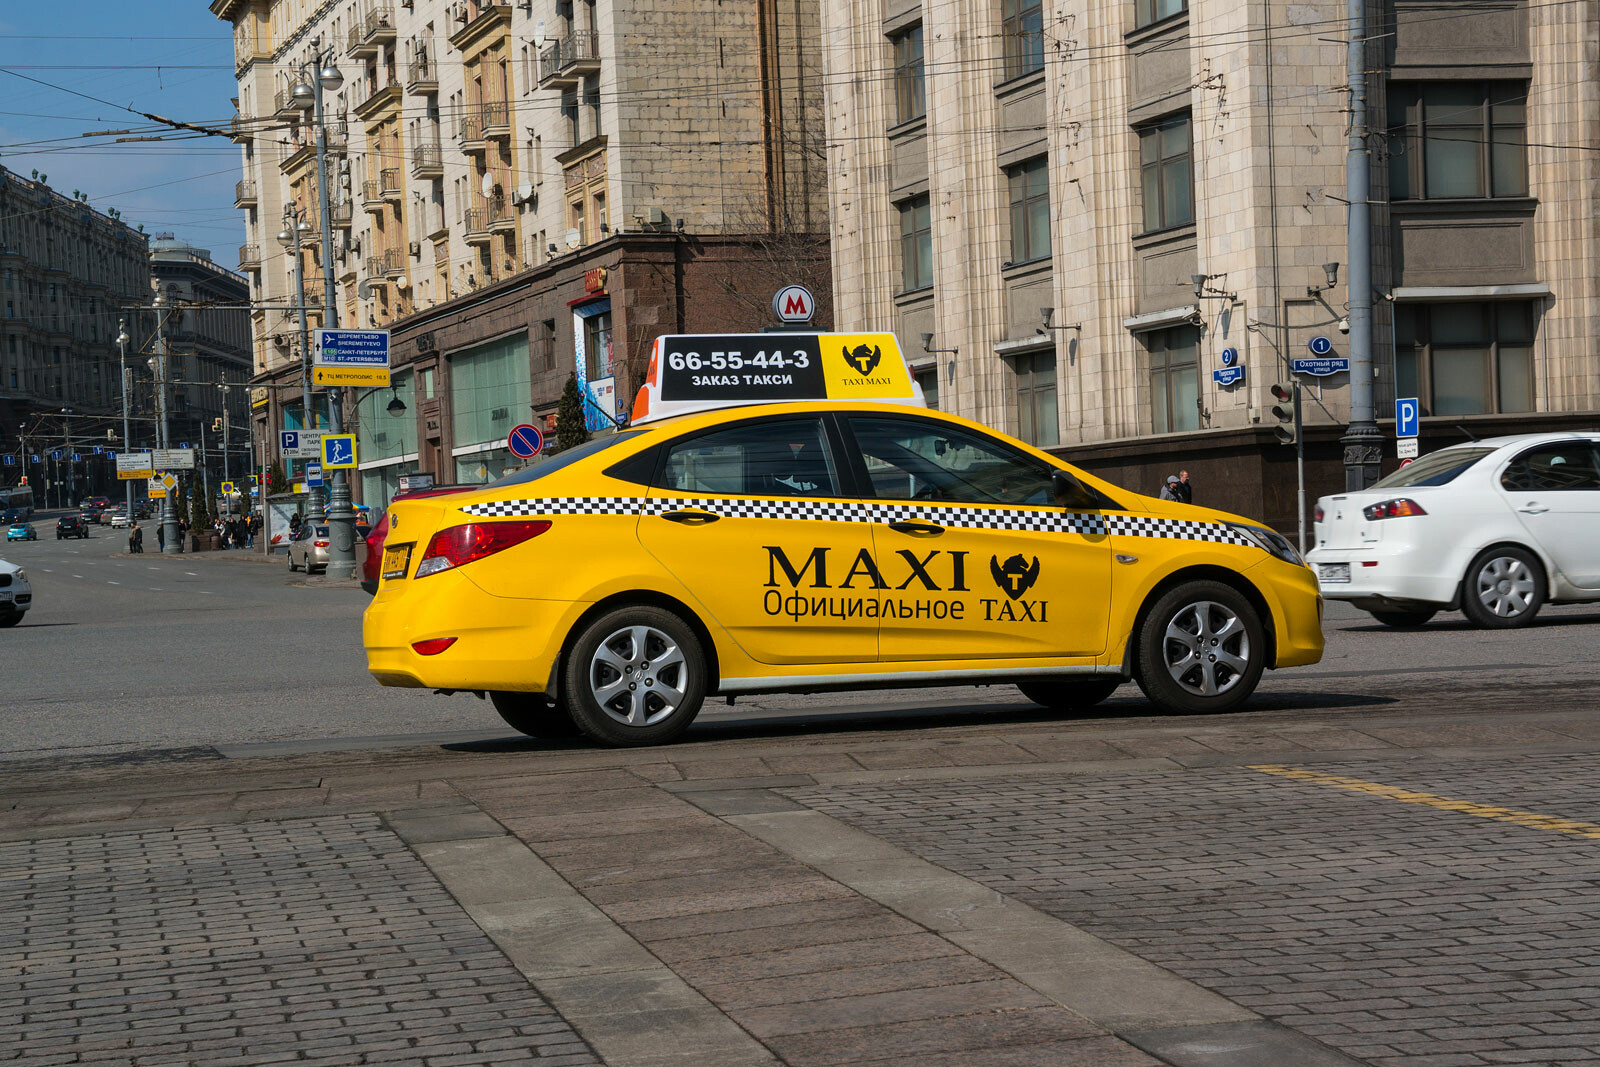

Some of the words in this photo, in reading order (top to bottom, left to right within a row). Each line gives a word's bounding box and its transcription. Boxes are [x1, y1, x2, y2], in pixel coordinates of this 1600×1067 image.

[1318, 340, 1324, 350] 1
[668, 350, 810, 370] 66-55-44-3
[1224, 352, 1229, 362] 2
[1299, 360, 1331, 368] Охотный
[1331, 360, 1344, 368] ряд
[691, 375, 740, 386] ЗАКАЗ
[742, 374, 793, 386] ТАКСИ
[841, 377, 865, 386] TAXI
[865, 377, 891, 386] MAXI
[761, 545, 971, 592] MAXI
[763, 589, 965, 622] Официальное
[979, 598, 1049, 623] TAXI
